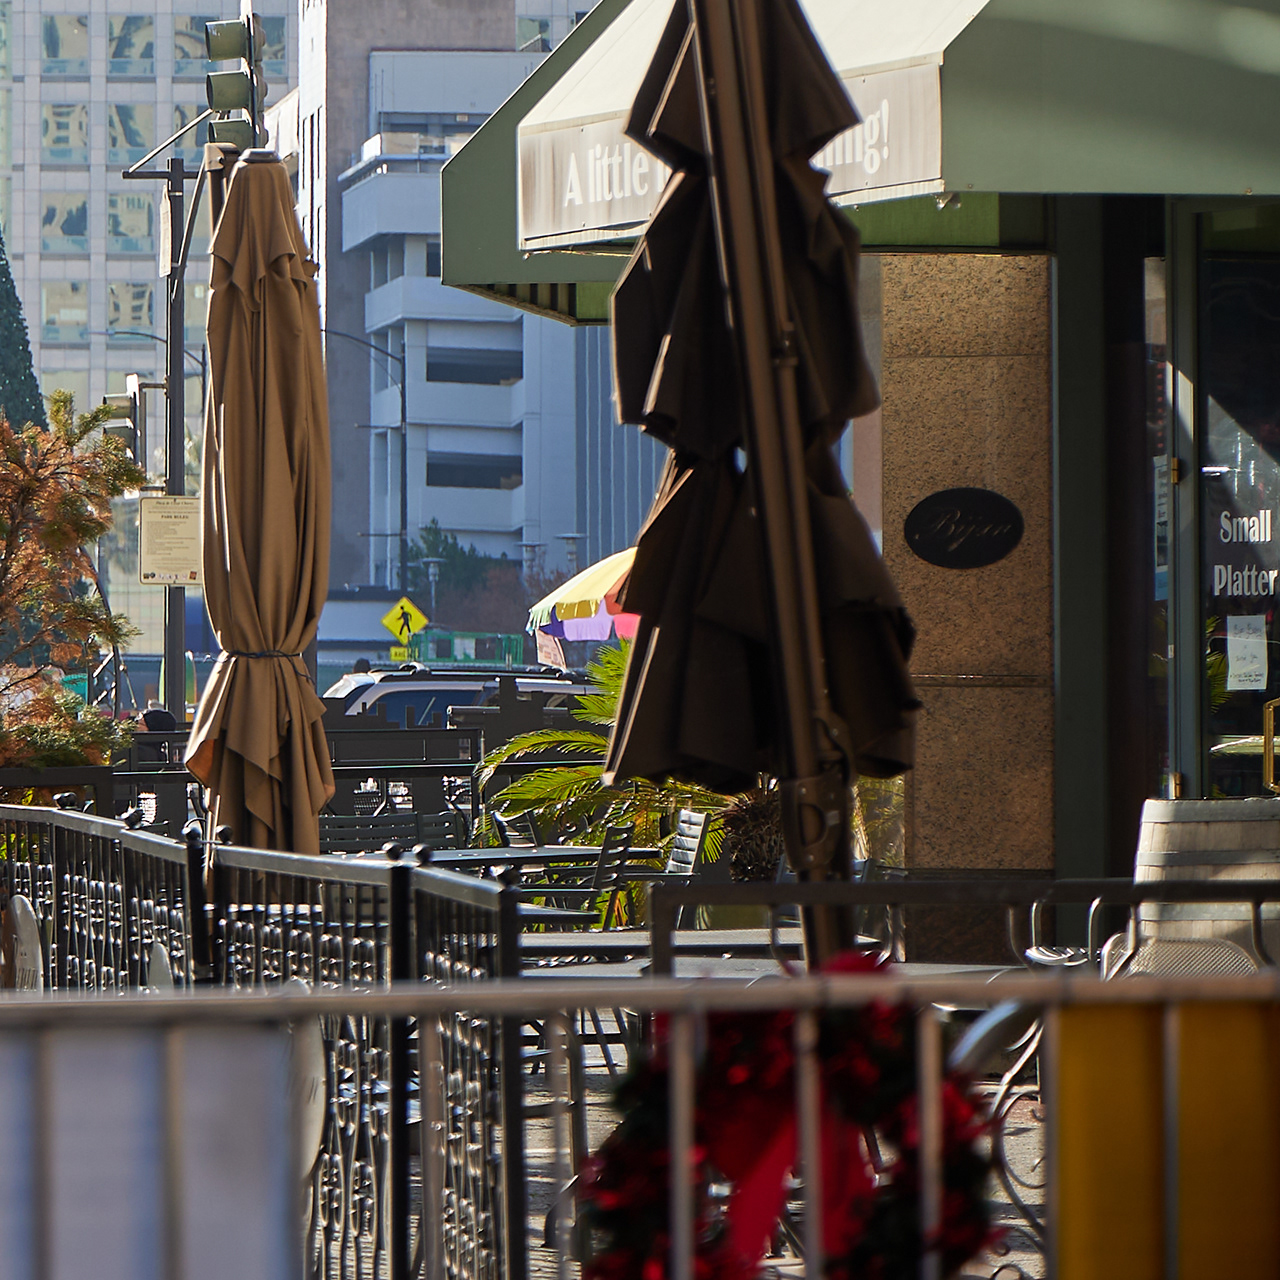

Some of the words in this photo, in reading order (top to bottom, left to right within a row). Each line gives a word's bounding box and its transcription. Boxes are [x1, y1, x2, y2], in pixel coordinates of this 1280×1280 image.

[563, 152, 584, 208] A
[588, 142, 649, 203] little
[1220, 509, 1272, 543] Small
[1213, 564, 1279, 597] Platter
